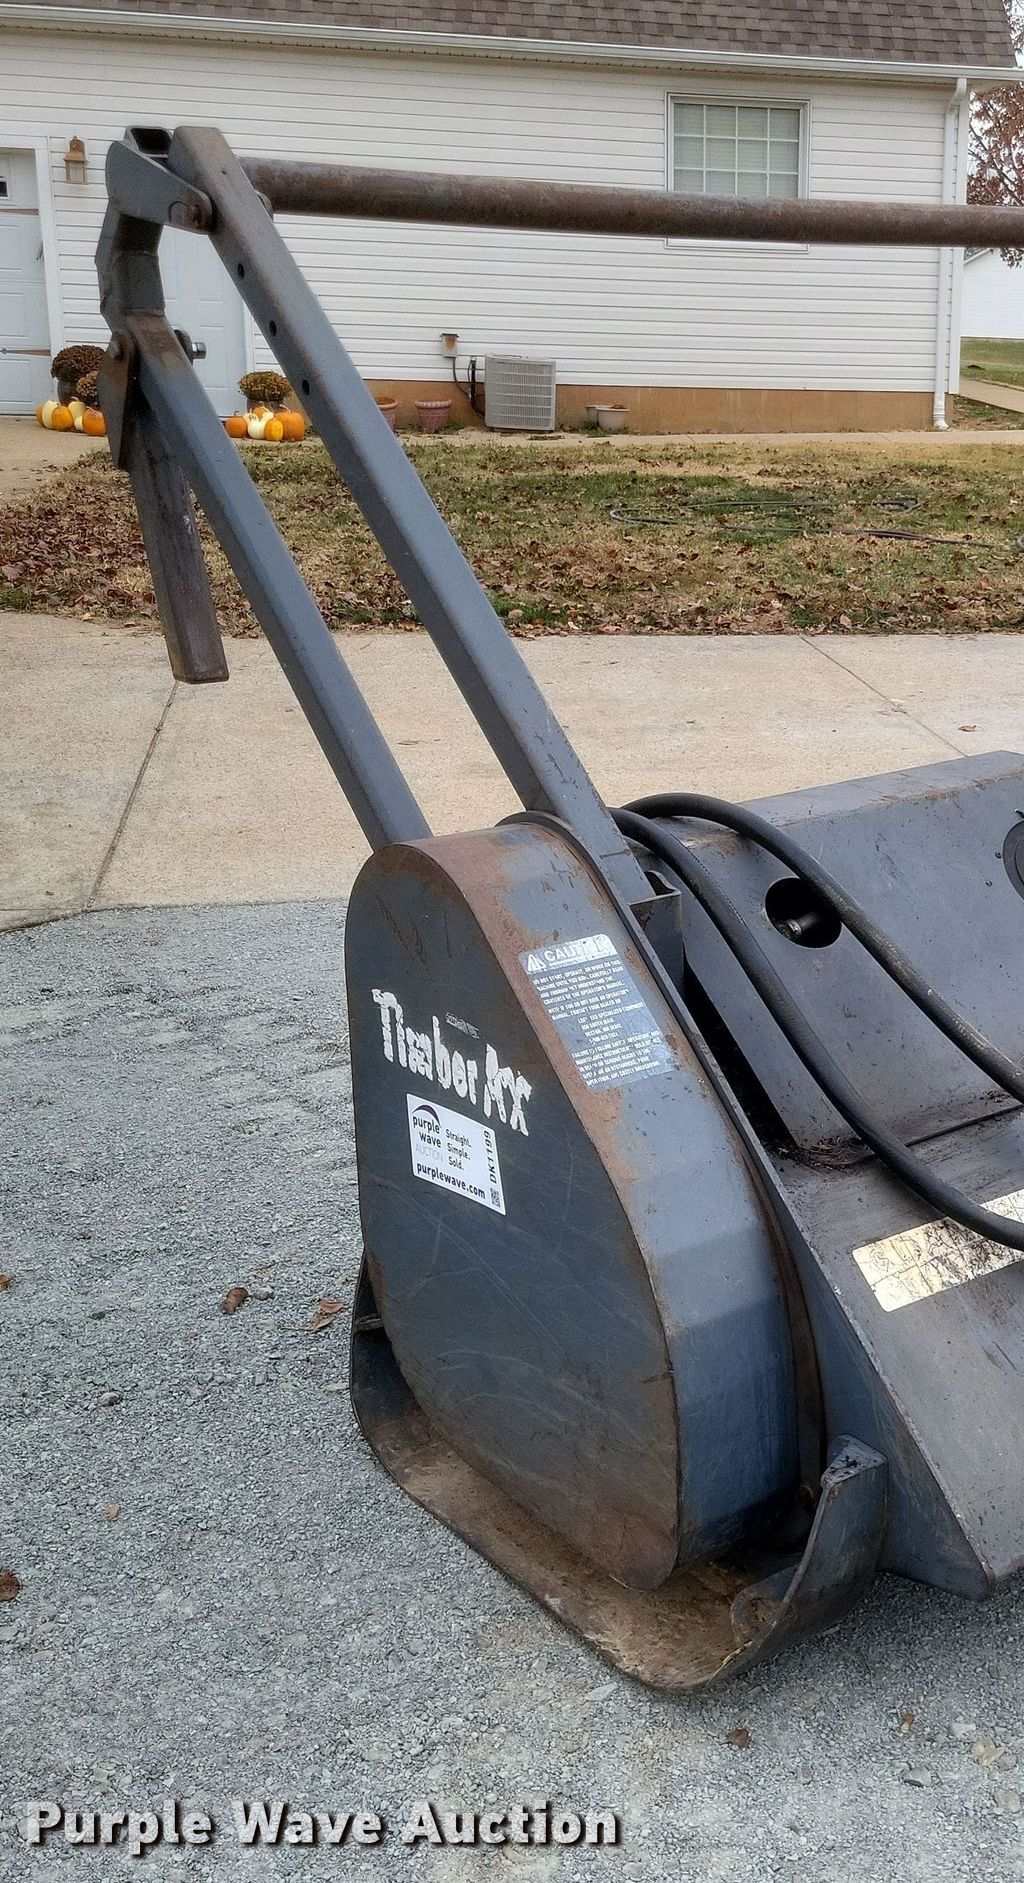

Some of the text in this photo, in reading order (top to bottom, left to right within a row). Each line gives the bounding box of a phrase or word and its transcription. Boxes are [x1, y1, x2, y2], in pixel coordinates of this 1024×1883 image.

[412, 1115, 440, 1134] purple
[419, 1131, 442, 1148] wave
[445, 1128, 472, 1147] Straight.
[447, 1142, 471, 1160] Simple.
[483, 1130, 497, 1184] DK1199
[448, 1156, 464, 1170] Sold.
[416, 1162, 486, 1200] purplewave.com
